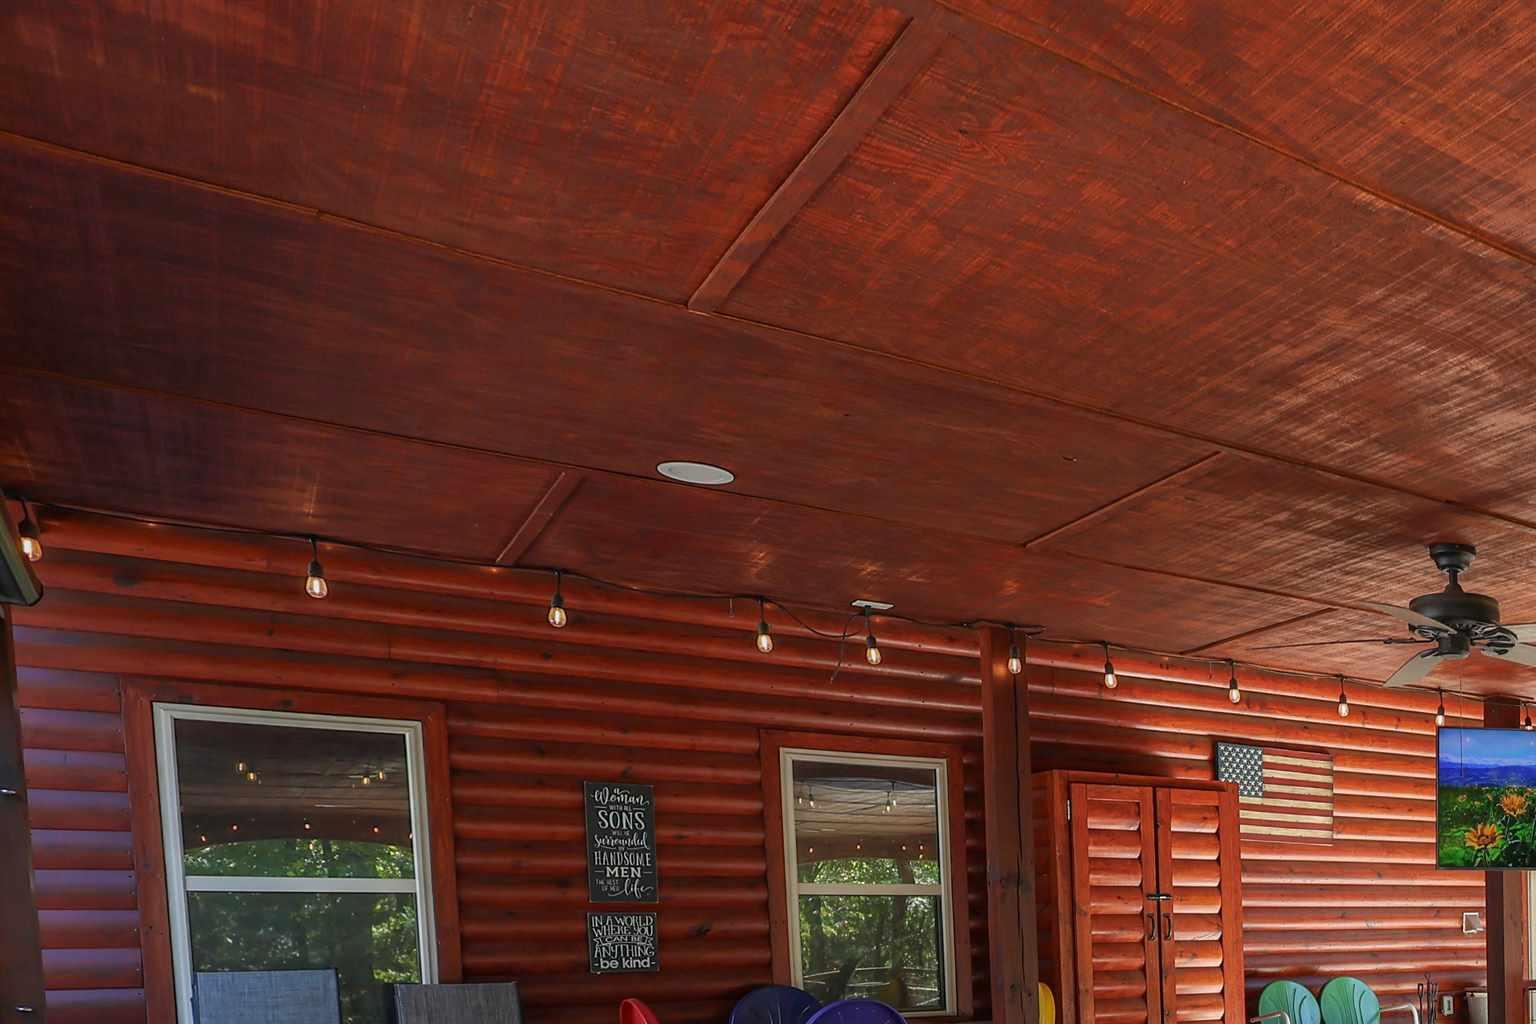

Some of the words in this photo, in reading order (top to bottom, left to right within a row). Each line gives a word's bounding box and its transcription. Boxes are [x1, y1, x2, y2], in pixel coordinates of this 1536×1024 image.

[592, 787, 650, 805] Woman
[598, 809, 646, 830] SONS
[594, 851, 652, 866] HANDSOME
[606, 866, 642, 878] MEN
[592, 915, 603, 927] IN
[614, 915, 654, 928] WORLD
[592, 925, 631, 937] WHERE
[633, 925, 654, 937] YOU
[594, 944, 655, 959] ANYTHING
